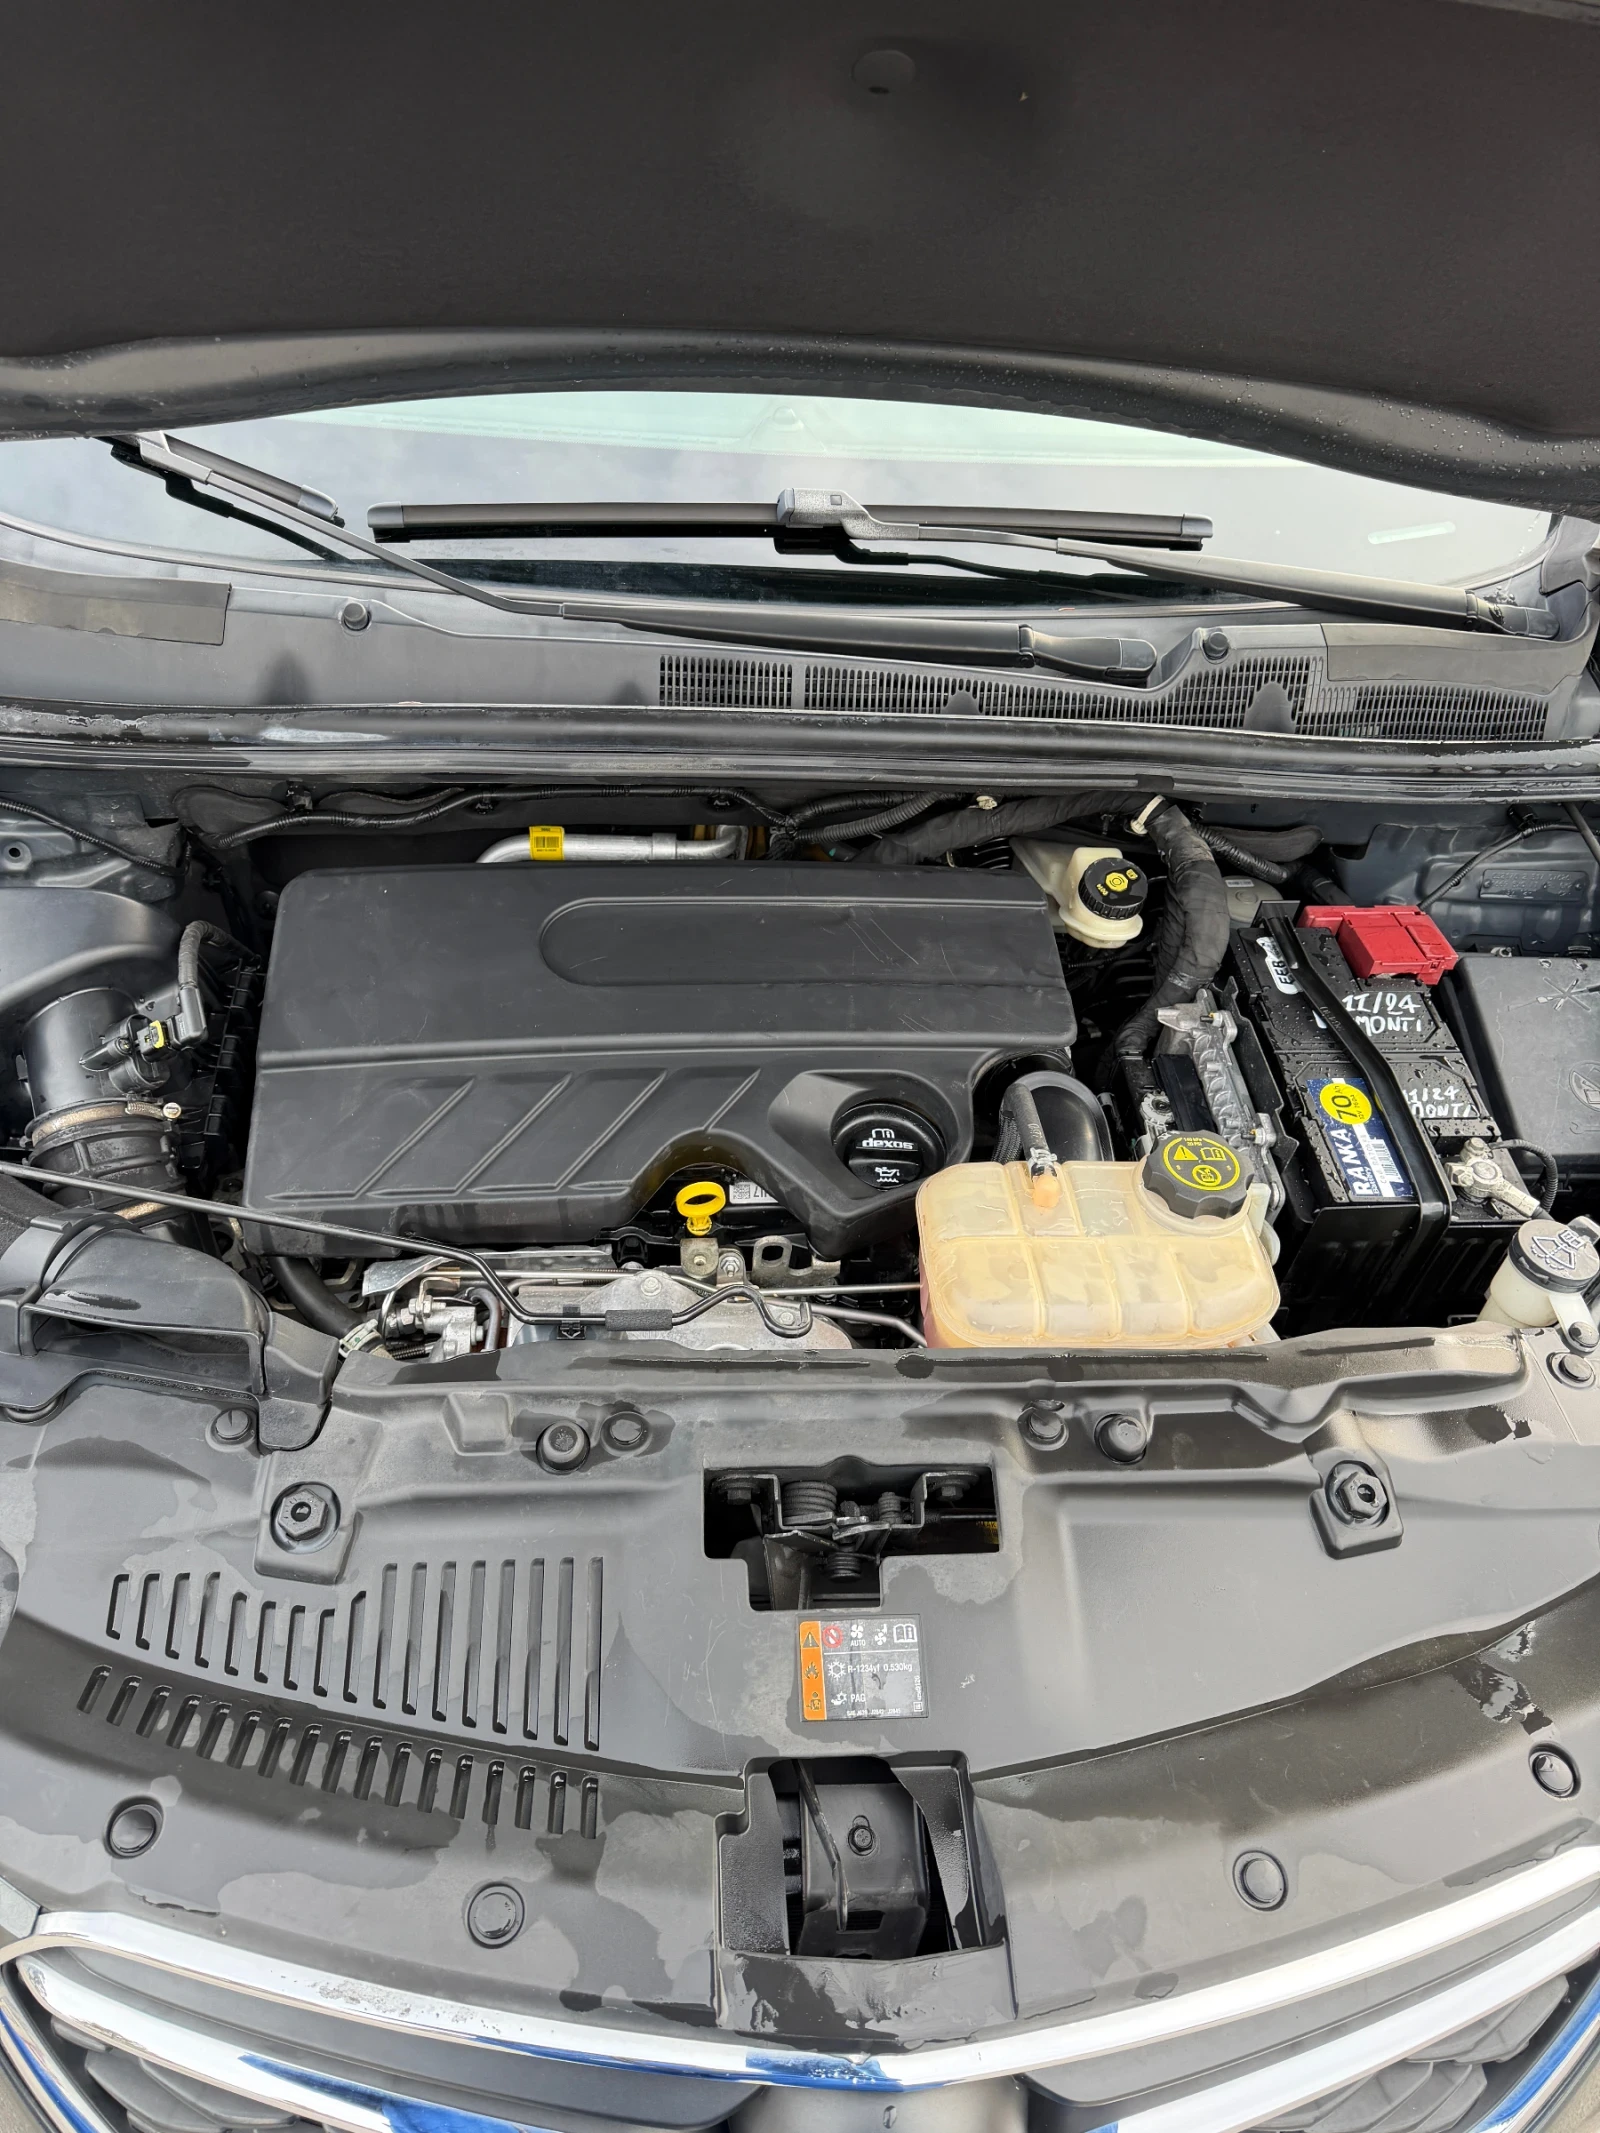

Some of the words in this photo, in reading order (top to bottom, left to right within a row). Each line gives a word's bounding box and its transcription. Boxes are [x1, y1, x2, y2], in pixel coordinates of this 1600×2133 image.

[1331, 1095, 1358, 1120] 70
[861, 1137, 915, 1150] dexos
[1330, 1129, 1374, 1195] RANKA
[850, 1639, 866, 1647] AUTO
[847, 1664, 880, 1674] R-1234yf
[883, 1662, 913, 1672] 0.530kg
[850, 1693, 867, 1703] PAG
